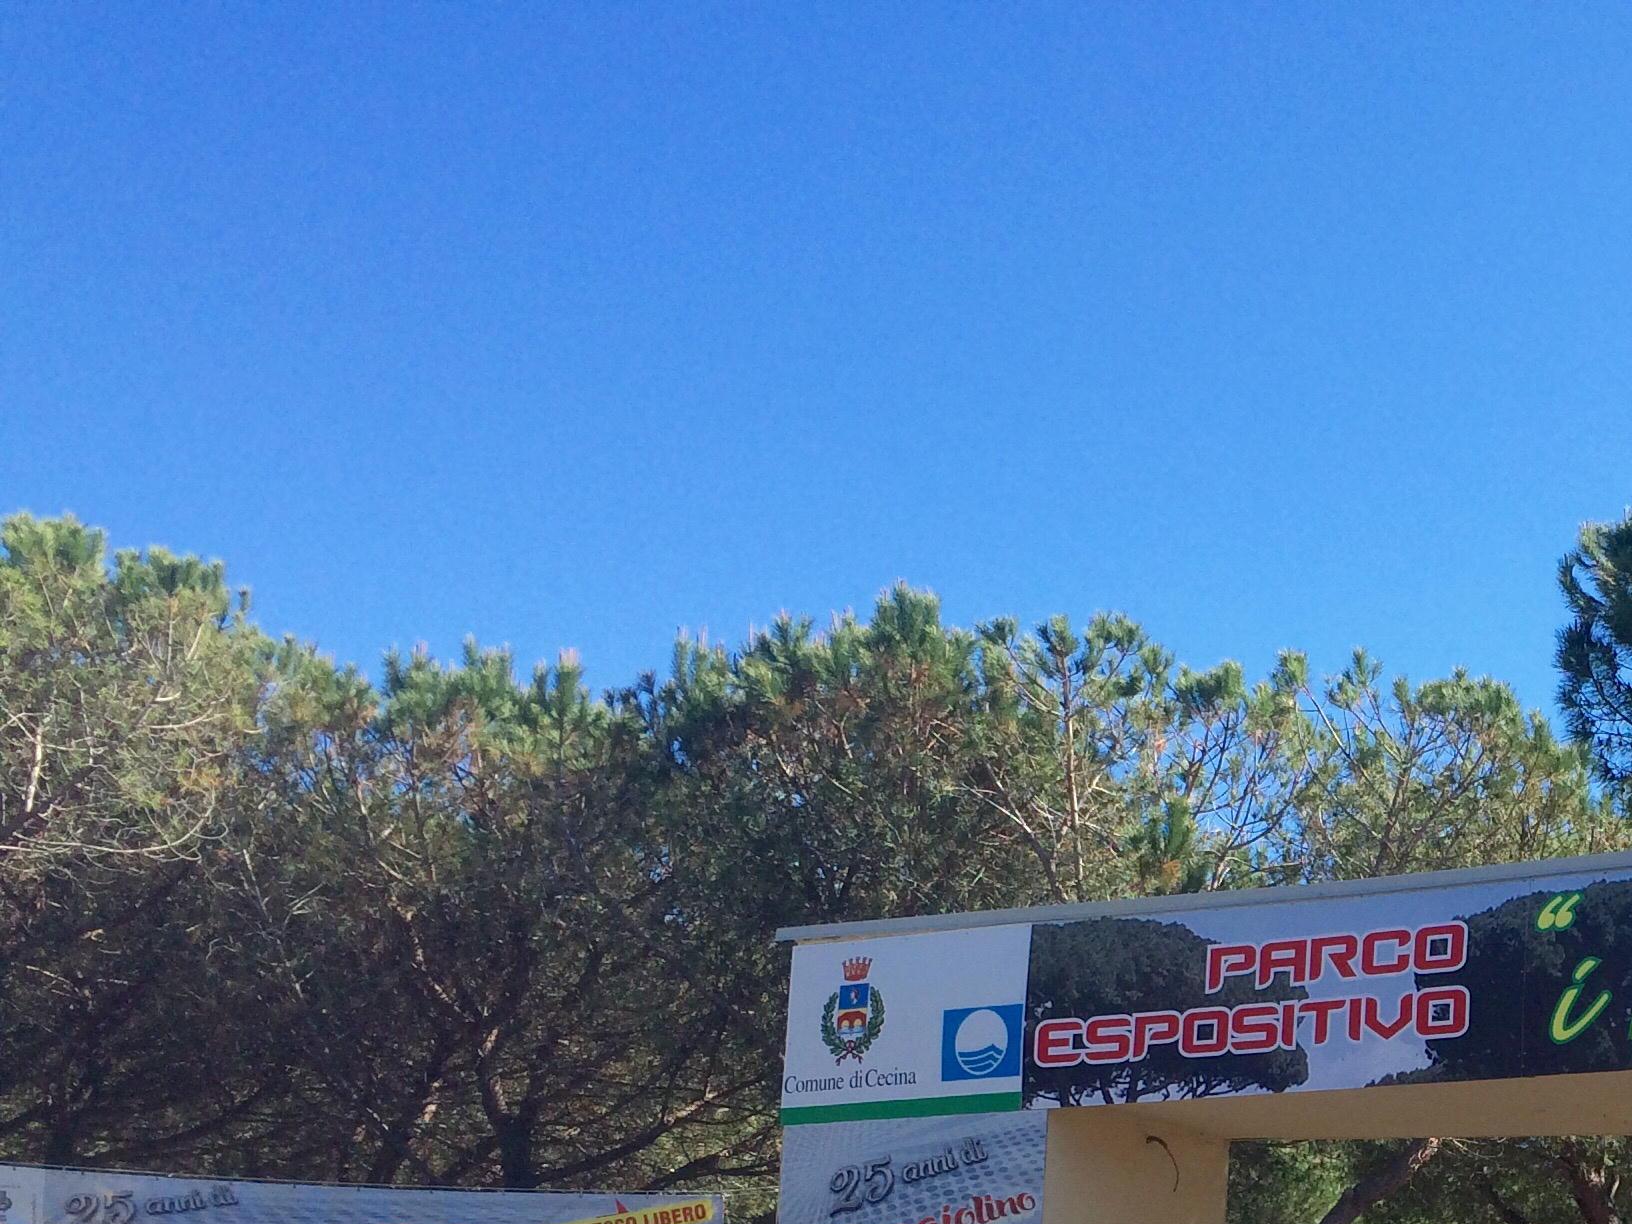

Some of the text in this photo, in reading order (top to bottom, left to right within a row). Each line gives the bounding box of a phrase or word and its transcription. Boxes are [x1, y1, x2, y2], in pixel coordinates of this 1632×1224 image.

[1207, 922, 1467, 993] PARCO
[1034, 986, 1469, 1066] ESPOSITIVO
[784, 1067, 917, 1094] Comune di Cecina
[146, 1190, 206, 1216] anni
[831, 1137, 989, 1217] 25 anni di
